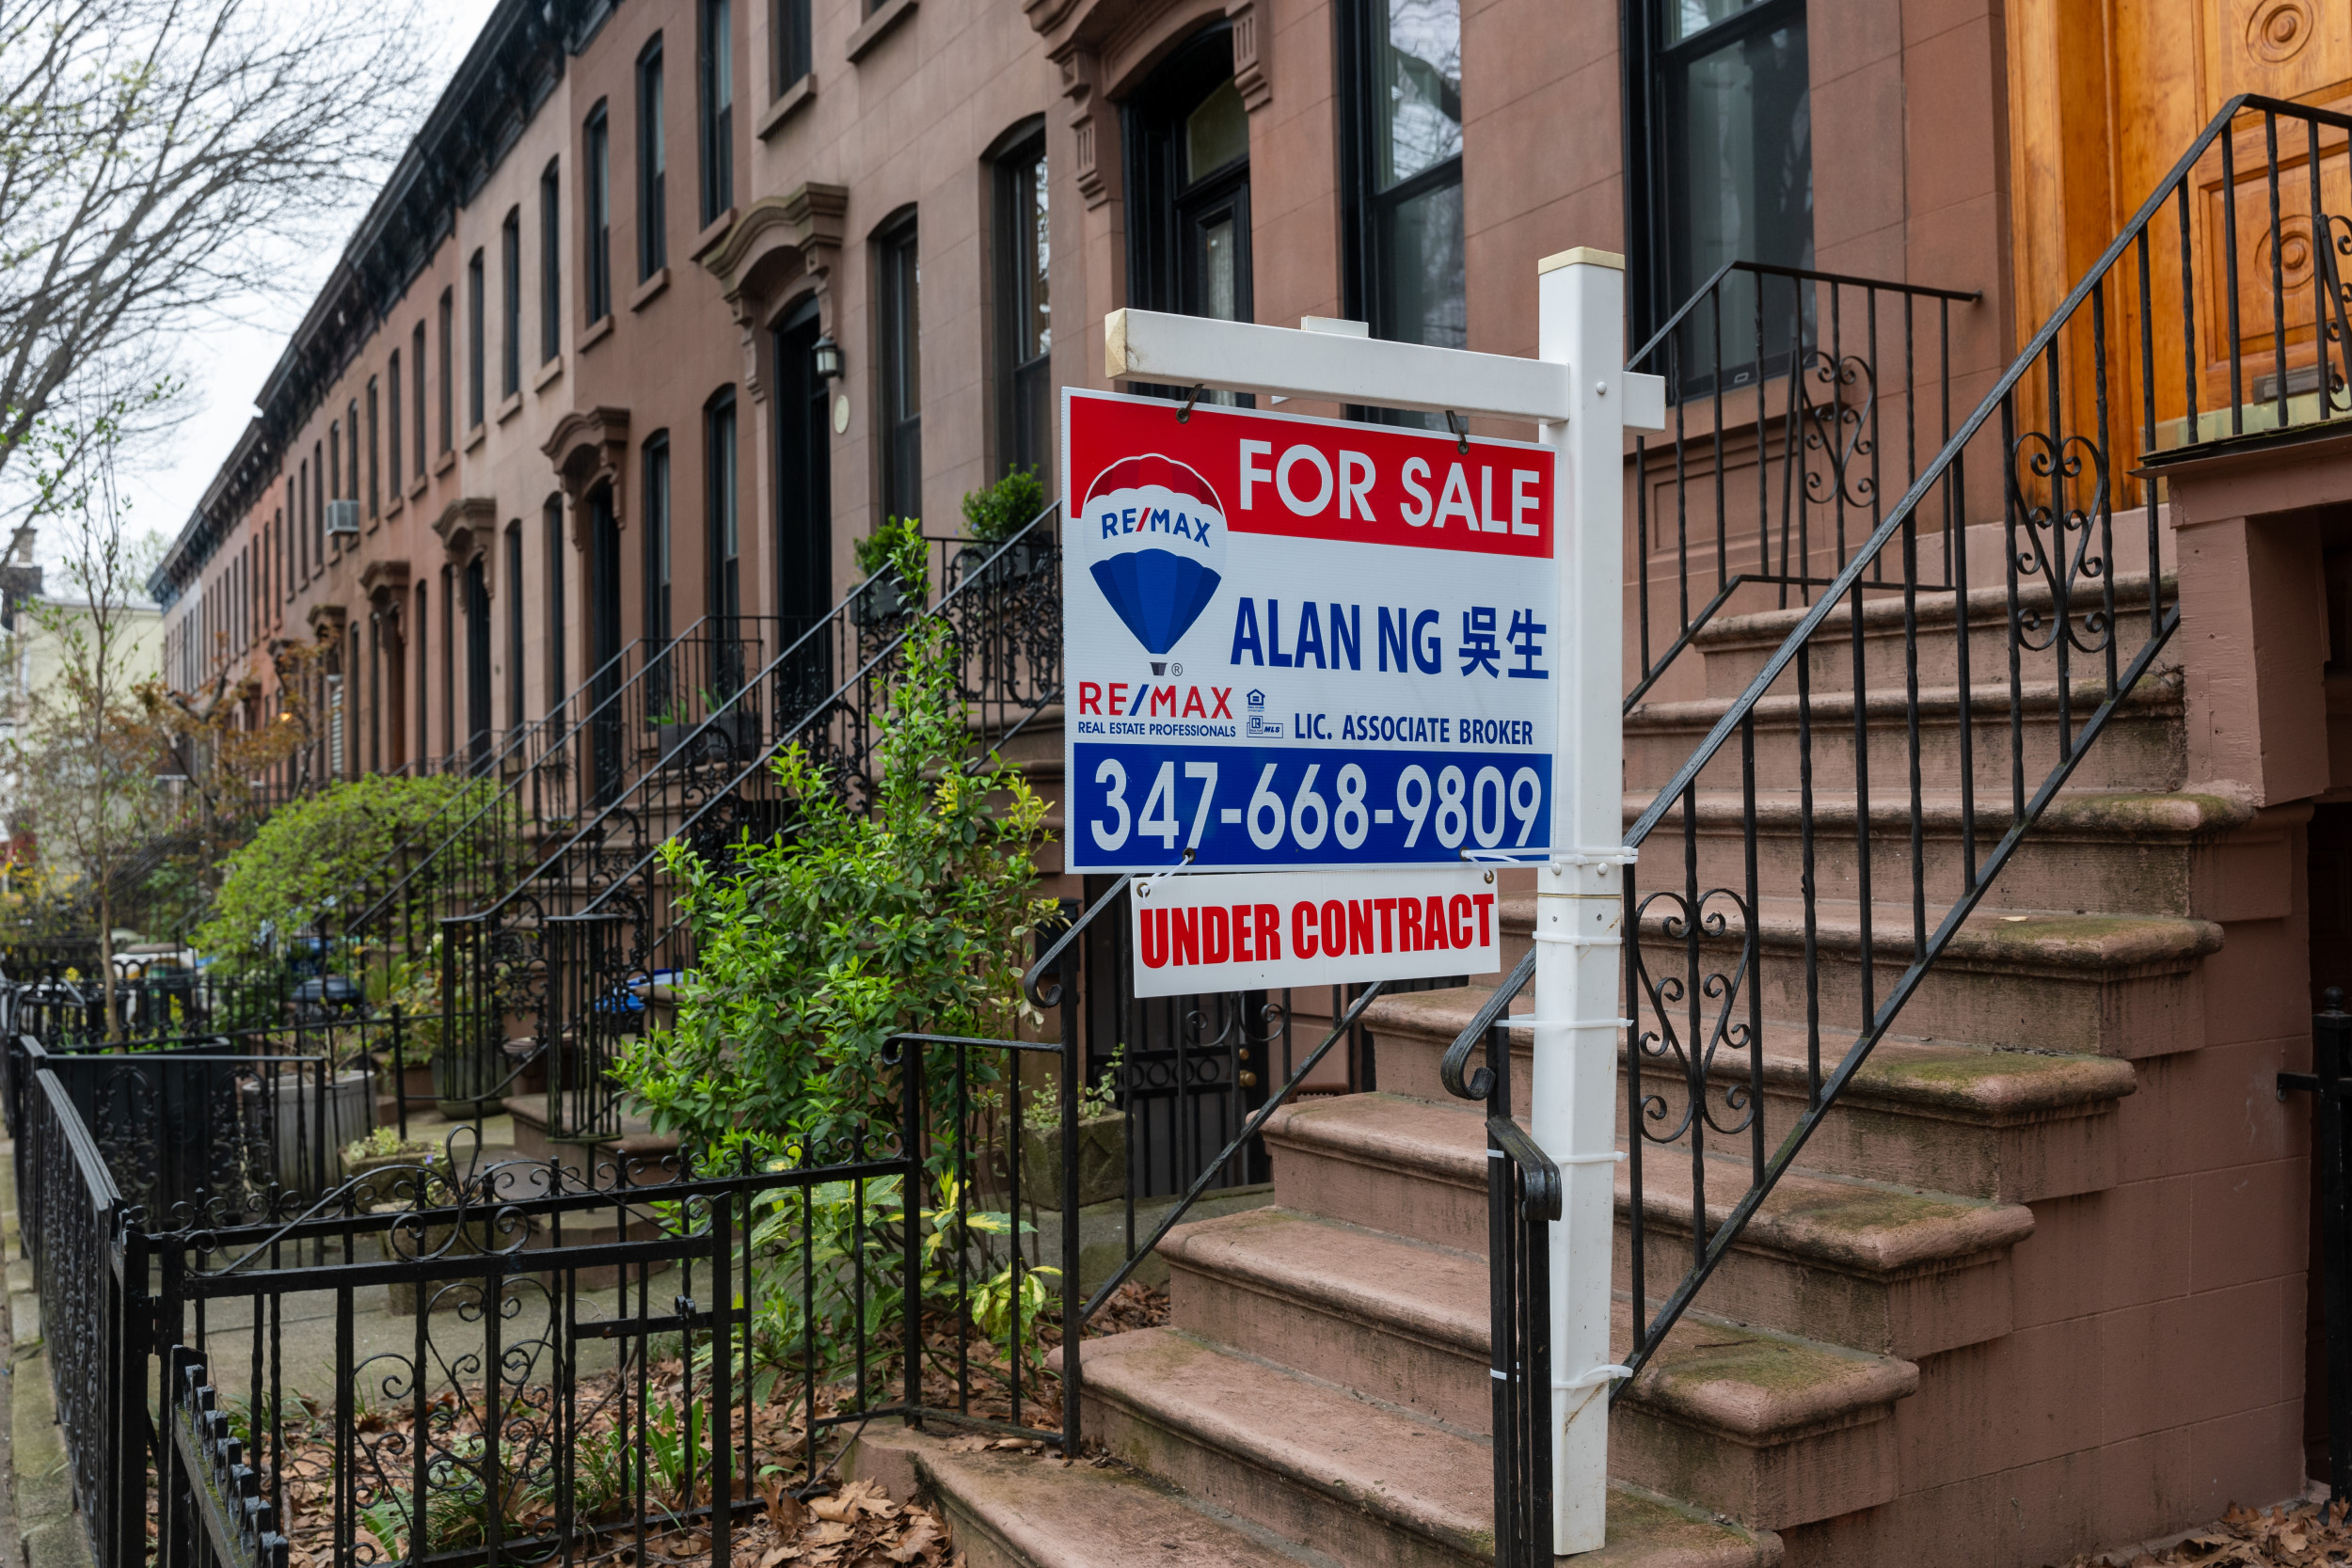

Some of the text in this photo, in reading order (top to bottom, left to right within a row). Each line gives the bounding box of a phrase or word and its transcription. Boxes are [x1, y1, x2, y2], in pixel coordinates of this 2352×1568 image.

[1240, 439, 1540, 537] FOR SALE
[1100, 507, 1212, 548] RE/MAX
[1230, 596, 1362, 672] ALAN
[1377, 606, 1442, 675] NG
[1078, 721, 1236, 737] REAL ESTATE PROFESSIONALS
[1079, 681, 1233, 720] RE/MAX
[1295, 712, 1534, 745] LIC. ASSOCIATE BROKER
[1090, 758, 1542, 851] 347-668-9809
[1139, 893, 1494, 969] UNDER CONTRACT
